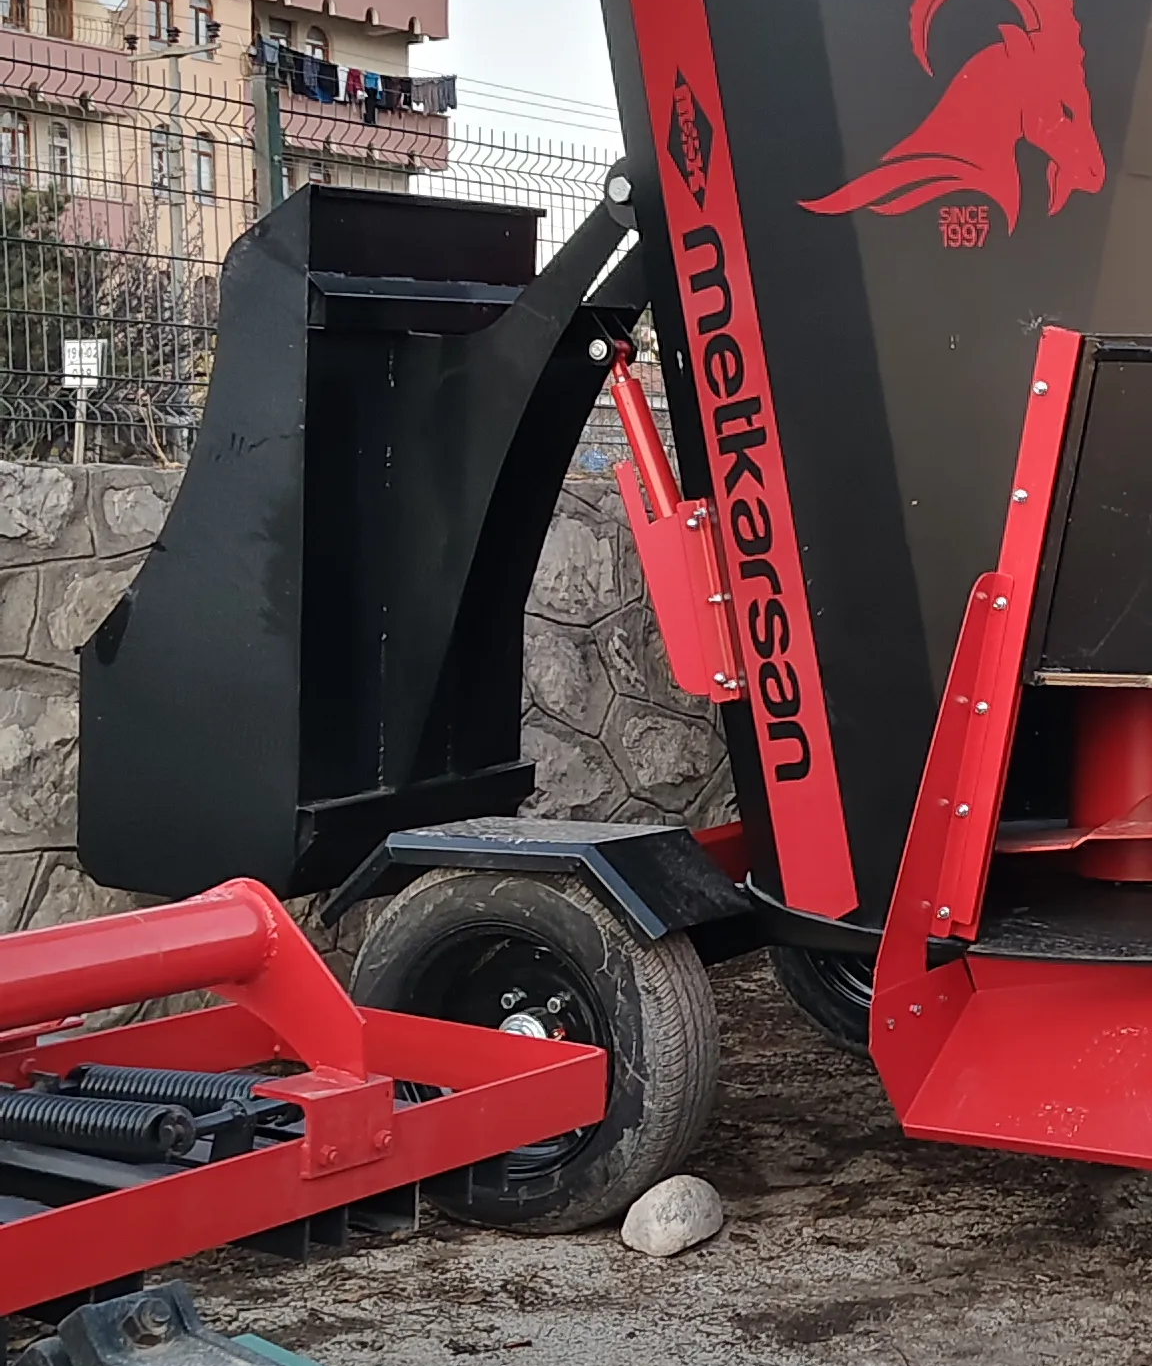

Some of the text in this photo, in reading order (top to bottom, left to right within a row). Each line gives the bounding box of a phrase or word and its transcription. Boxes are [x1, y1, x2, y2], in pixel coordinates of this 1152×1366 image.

[938, 206, 989, 223] SINCE
[938, 223, 990, 248] 1997
[682, 224, 812, 784] metkarsan
